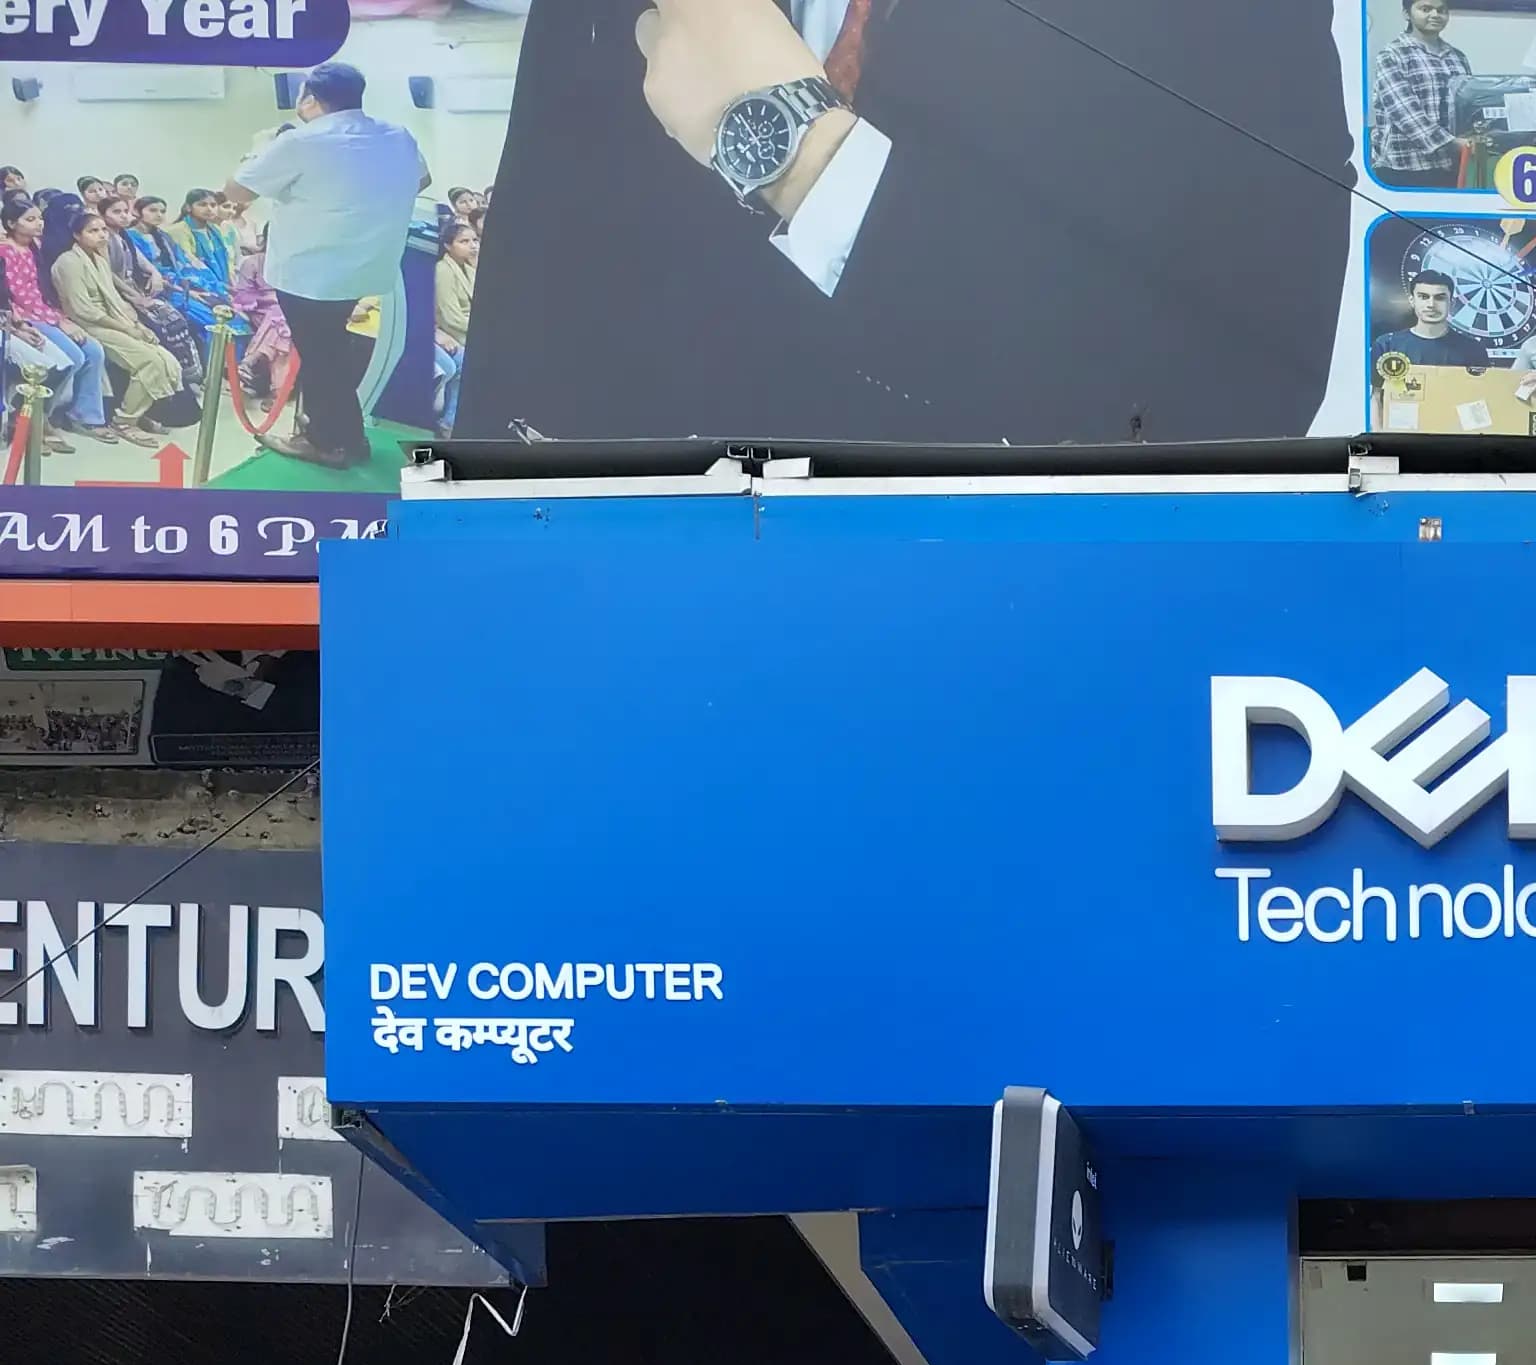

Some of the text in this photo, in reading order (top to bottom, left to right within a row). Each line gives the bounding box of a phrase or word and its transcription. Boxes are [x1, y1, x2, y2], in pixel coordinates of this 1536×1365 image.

[140, 0, 307, 40] Year
[131, 513, 188, 554] to
[209, 512, 240, 554] 6
[369, 961, 725, 1002] DEV COMPUTER
[372, 1006, 575, 1065] देव कम्प्यूटर
